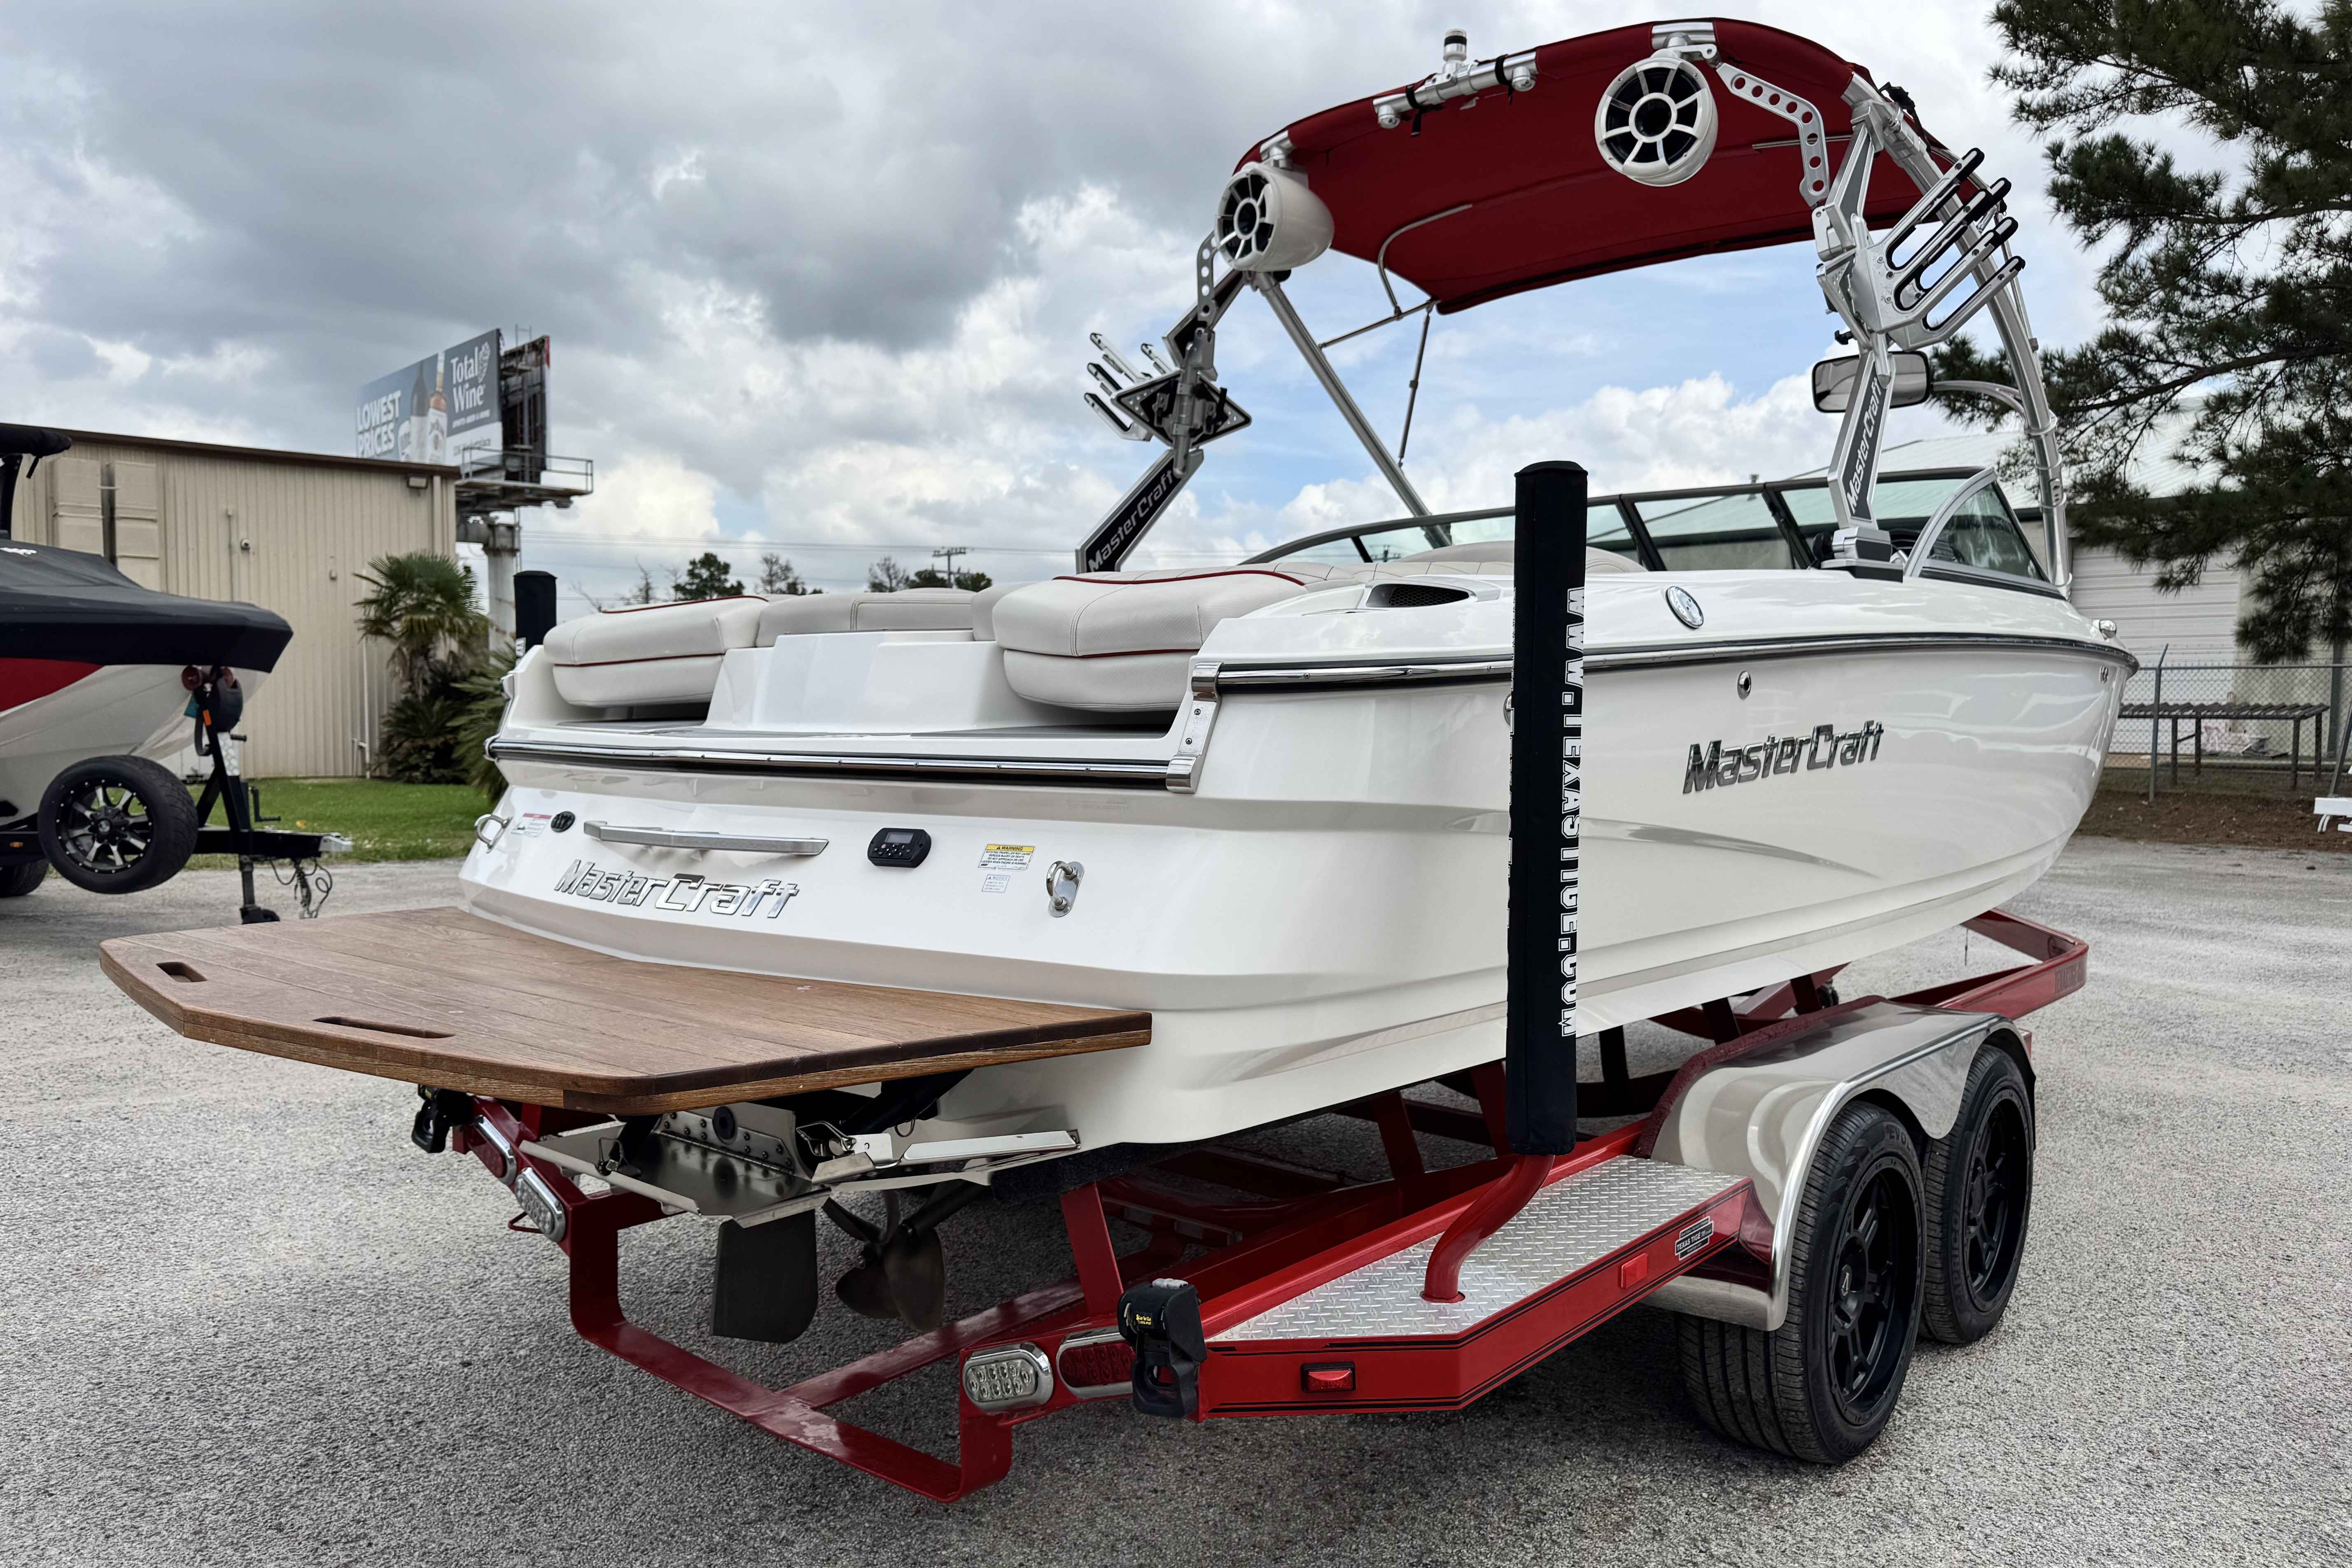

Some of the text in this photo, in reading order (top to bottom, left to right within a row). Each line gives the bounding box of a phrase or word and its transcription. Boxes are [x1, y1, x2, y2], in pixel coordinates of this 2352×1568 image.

[450, 346, 478, 385] Total
[357, 390, 402, 431] LOWEST
[453, 383, 484, 413] Wine
[357, 422, 396, 458] PRICES
[1846, 377, 1882, 514] MasterCraft
[1087, 469, 1174, 572] MasterCraft
[1682, 720, 1884, 794] MasterCraft
[554, 859, 800, 919] MasterCraft
